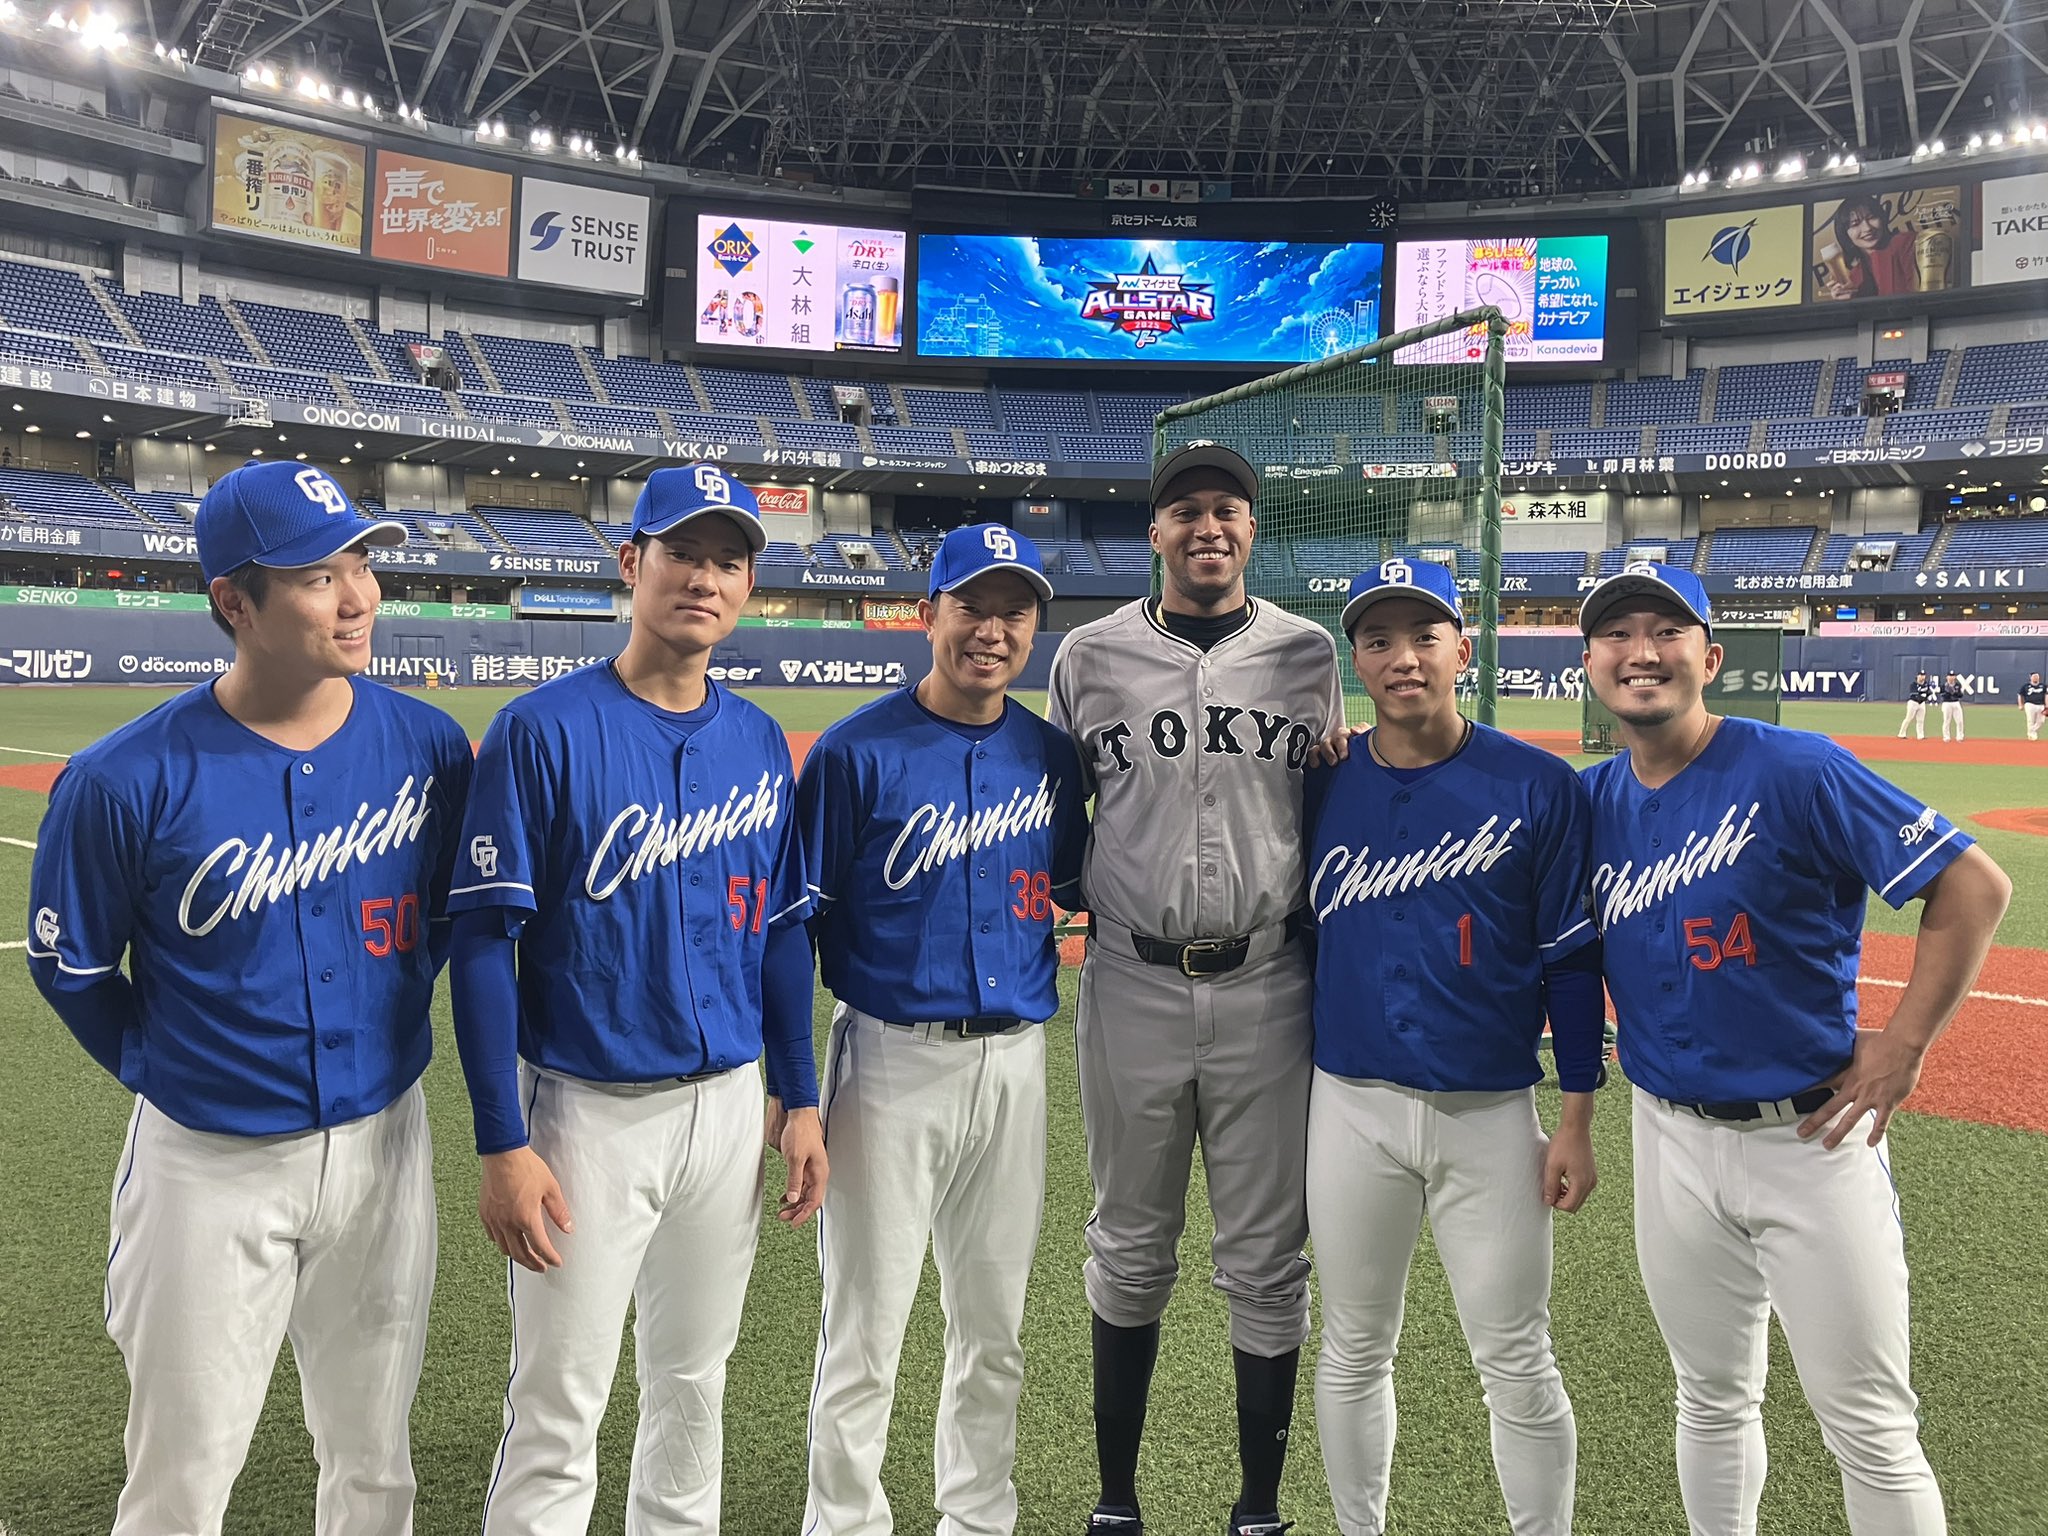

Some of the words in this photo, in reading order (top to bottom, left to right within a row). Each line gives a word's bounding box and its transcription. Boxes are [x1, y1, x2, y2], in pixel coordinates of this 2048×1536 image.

[246, 149, 264, 211] 一番搾り
[382, 167, 445, 208] 声で
[380, 201, 508, 234] 世界を変える!
[1111, 214, 1198, 227] 京セラドーム大阪
[571, 215, 639, 242] SENSE
[571, 238, 637, 265] TRUST
[713, 239, 752, 256] ORIX
[1539, 257, 1578, 273] 地球の、
[1141, 279, 1176, 289] マイナビ
[1673, 277, 1793, 305] エイジェック
[791, 266, 811, 344] 大林組
[1538, 293, 1599, 308] 希望になれ。
[1123, 311, 1172, 320] GAME
[1537, 311, 1591, 326] カナデビア
[1537, 343, 1598, 355] Kanadevia
[113, 382, 196, 408] 日本建物
[304, 406, 401, 432] ONOCOM
[560, 433, 635, 452] YOKOHAMA
[663, 440, 702, 458] YKK
[703, 444, 728, 459] AP
[1989, 437, 2044, 455] フジタ
[782, 450, 841, 468] 内外電機
[1705, 452, 1787, 471] DOORDO
[1833, 445, 1926, 463] 日本カルミック
[975, 460, 1047, 476] 串かつだるま
[1603, 457, 1675, 473] 卯月林業
[1528, 501, 1586, 519] 森本組
[0, 525, 81, 546] か信用金庫
[504, 557, 551, 571] SENSE
[556, 559, 600, 573] TRUST
[802, 568, 885, 586] AZUMAGUMI
[1734, 574, 1853, 590] 北おおさか信用金庫
[1936, 570, 2024, 587] SAIKI
[17, 589, 78, 604] SENKO
[116, 593, 170, 607] センコー
[375, 603, 420, 616] SENKO
[451, 605, 496, 618] センコー
[766, 619, 795, 627] センコー
[822, 620, 851, 629] SENKO
[141, 657, 209, 672] docomo
[802, 660, 902, 683] ベガピック
[1752, 671, 1860, 693] SAMTY
[1101, 704, 1312, 773] TOKYO
[585, 770, 784, 901] Chunichi
[883, 772, 1062, 891] Chunichi
[179, 775, 434, 937] Chunichi
[1309, 814, 1522, 926] Chunichi
[1591, 801, 1760, 934] Chunichi
[1008, 868, 1051, 921] 38
[727, 875, 768, 935] 51
[360, 893, 419, 958] 50
[1457, 913, 1472, 966] 1
[1683, 912, 1757, 971] 54
